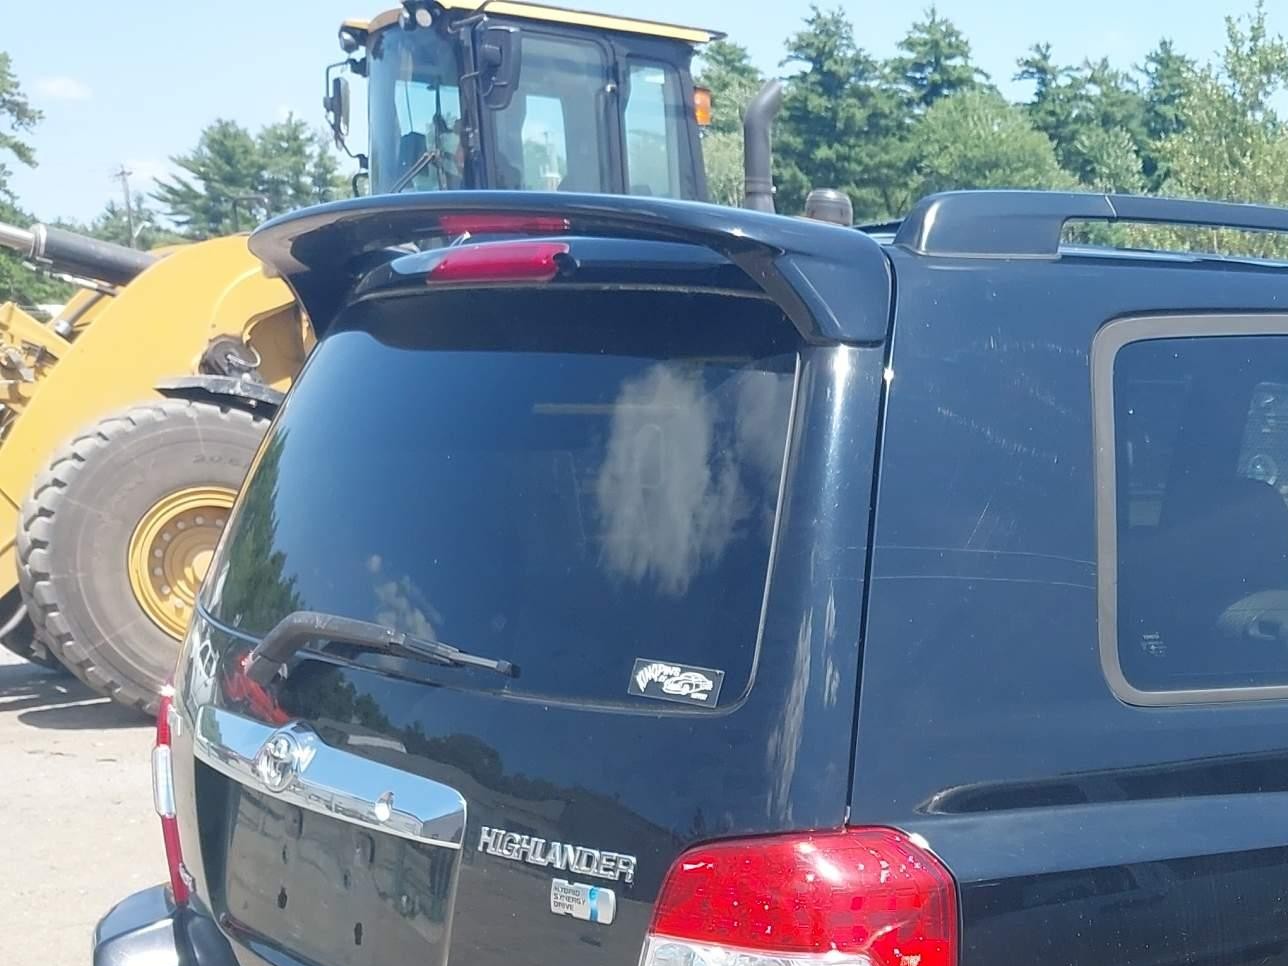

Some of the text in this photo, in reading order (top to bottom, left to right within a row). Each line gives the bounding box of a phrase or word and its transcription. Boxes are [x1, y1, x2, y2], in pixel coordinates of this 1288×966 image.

[477, 826, 636, 883] HIGHLANDER
[553, 886, 581, 897] HYBRID
[553, 893, 586, 905] SYNERGY
[553, 901, 575, 911] DRIVE
